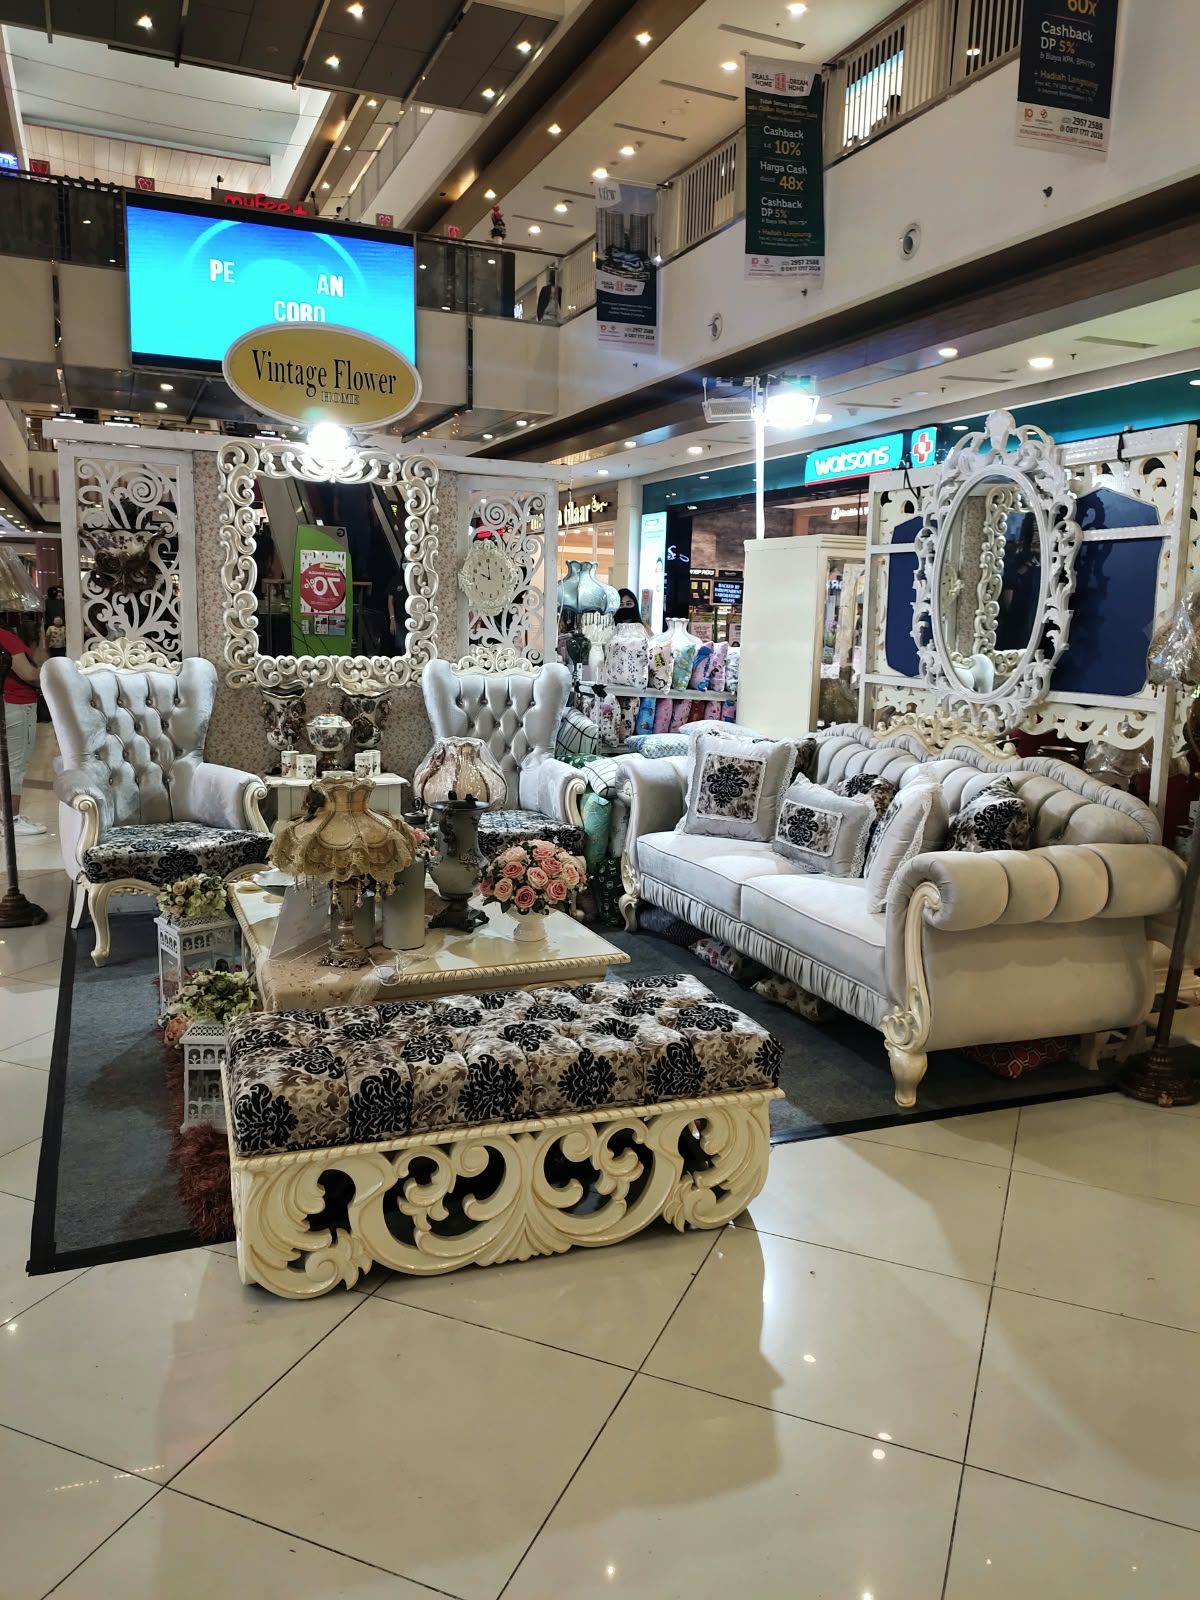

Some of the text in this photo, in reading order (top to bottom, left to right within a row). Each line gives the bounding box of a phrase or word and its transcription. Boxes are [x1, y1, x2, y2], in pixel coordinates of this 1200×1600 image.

[1041, 21, 1094, 43] Cashback
[1040, 37, 1057, 50] DP
[789, 78, 809, 86] DREAM
[1040, 69, 1067, 82] Hadiah
[1065, 125, 1079, 133] 0817
[1072, 116, 1087, 126] 2957
[1088, 121, 1103, 131] 2588
[763, 125, 804, 139] Cashback
[775, 140, 801, 156] 10%
[760, 161, 808, 175] Harga Cash
[779, 175, 804, 191] 48x
[761, 197, 803, 209] Cashback
[761, 208, 774, 217] DP
[209, 258, 343, 298] PE AN
[251, 349, 397, 398] Vintage Flower
[321, 391, 361, 405] HOME
[815, 446, 889, 475] watsons
